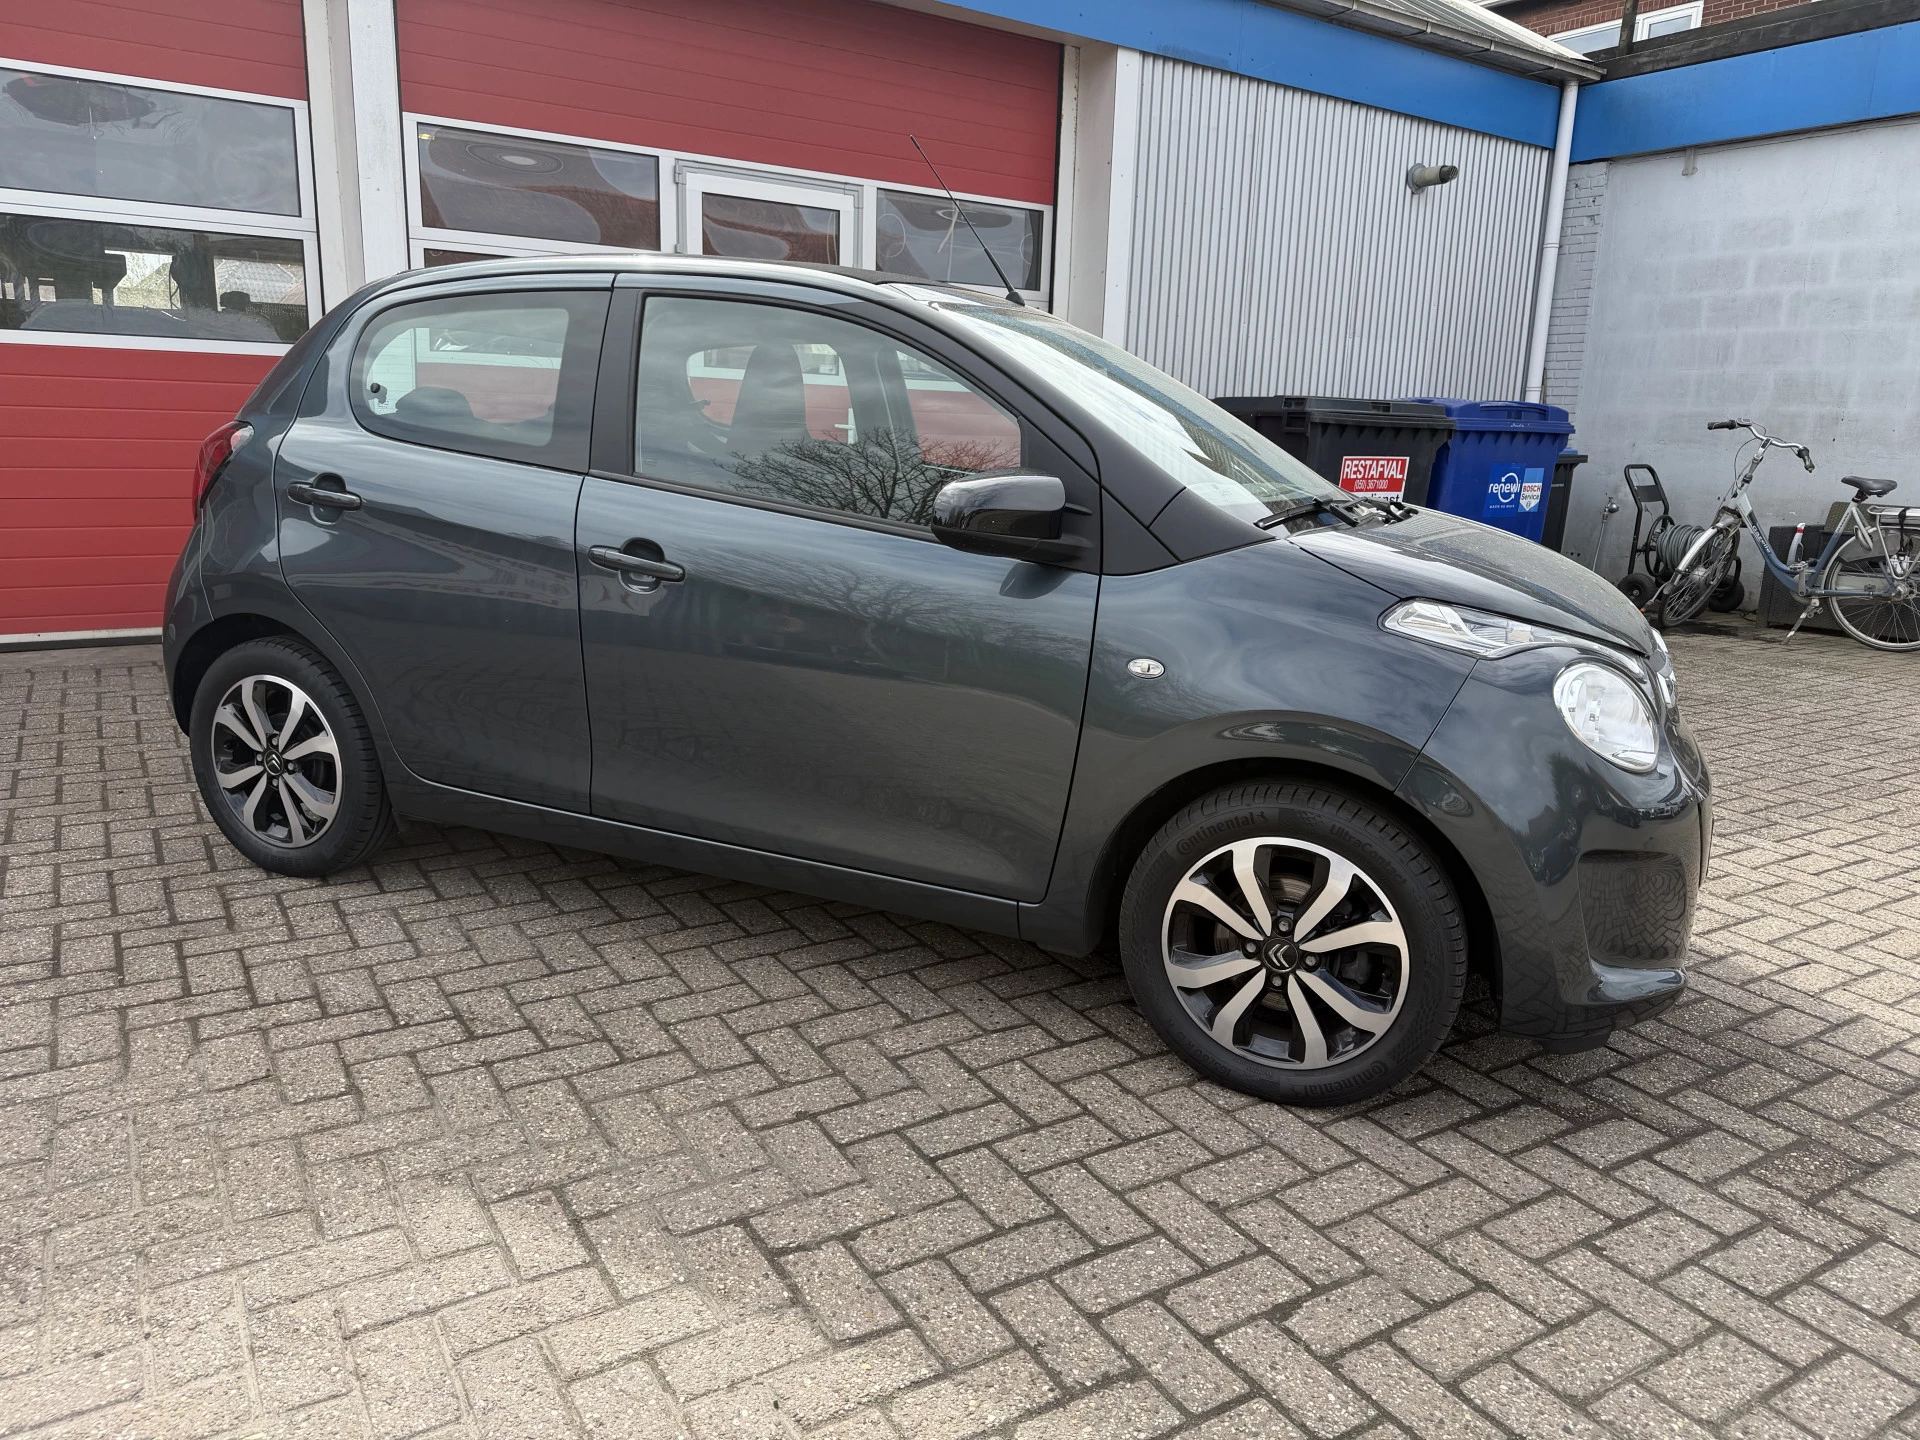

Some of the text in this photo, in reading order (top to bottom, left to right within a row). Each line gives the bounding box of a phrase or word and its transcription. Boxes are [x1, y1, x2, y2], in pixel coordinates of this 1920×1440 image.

[1343, 460, 1403, 479] RESTAFVAL
[1488, 479, 1521, 495] renewi
[1522, 484, 1541, 493] BOSCH
[1521, 493, 1540, 501] Service
[1176, 811, 1256, 856] Continental
[1329, 823, 1407, 885] UltraContact
[1306, 1060, 1388, 1096] Continental
